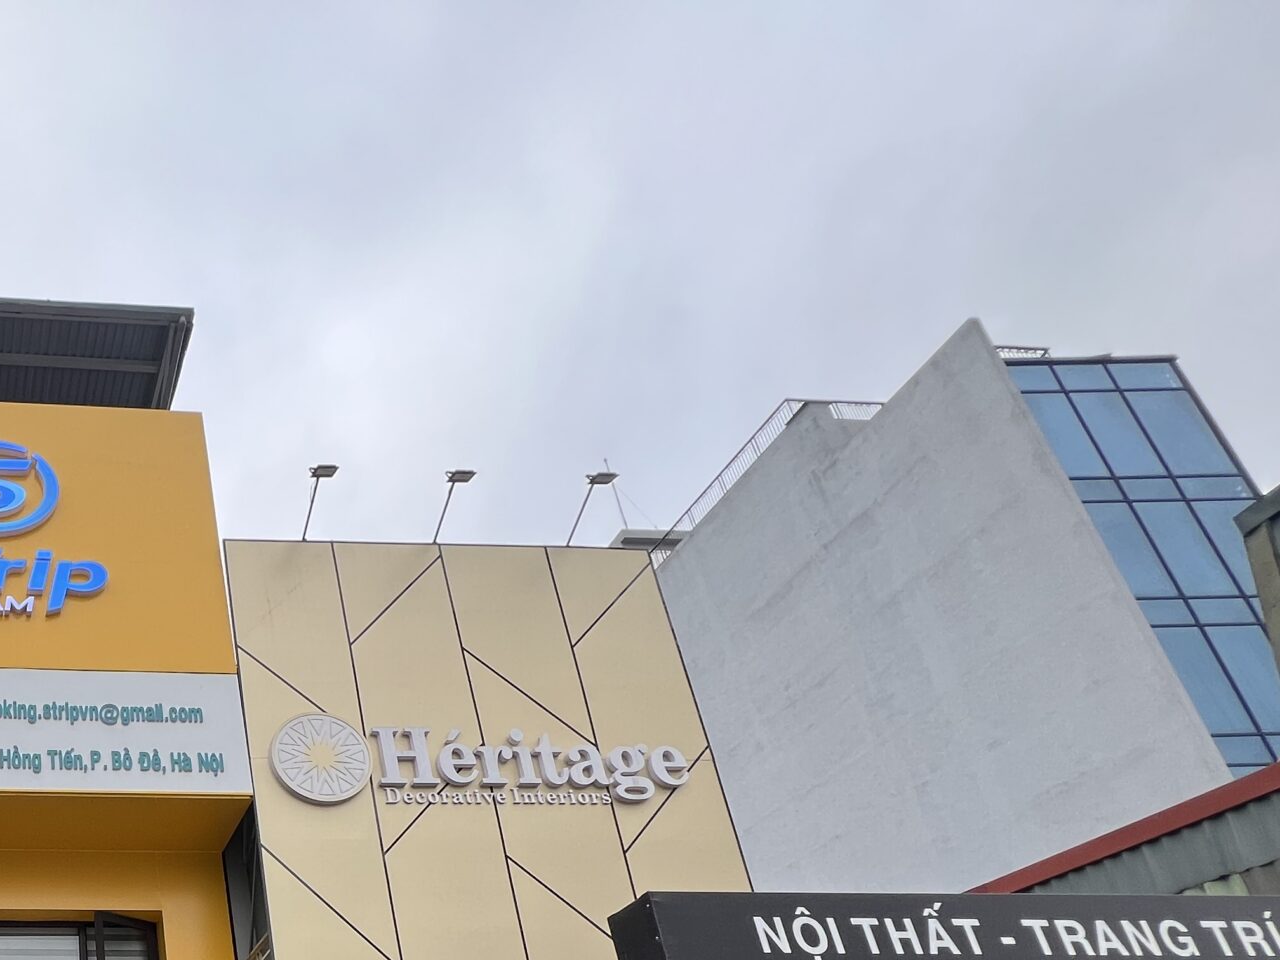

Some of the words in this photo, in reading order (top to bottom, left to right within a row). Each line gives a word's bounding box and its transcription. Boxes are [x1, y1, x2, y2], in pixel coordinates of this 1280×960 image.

[371, 727, 690, 803] Héritage
[384, 786, 506, 805] Decorative
[510, 786, 612, 805] Interiors
[849, 902, 983, 955] THẤT
[1020, 919, 1201, 956] TRANG
